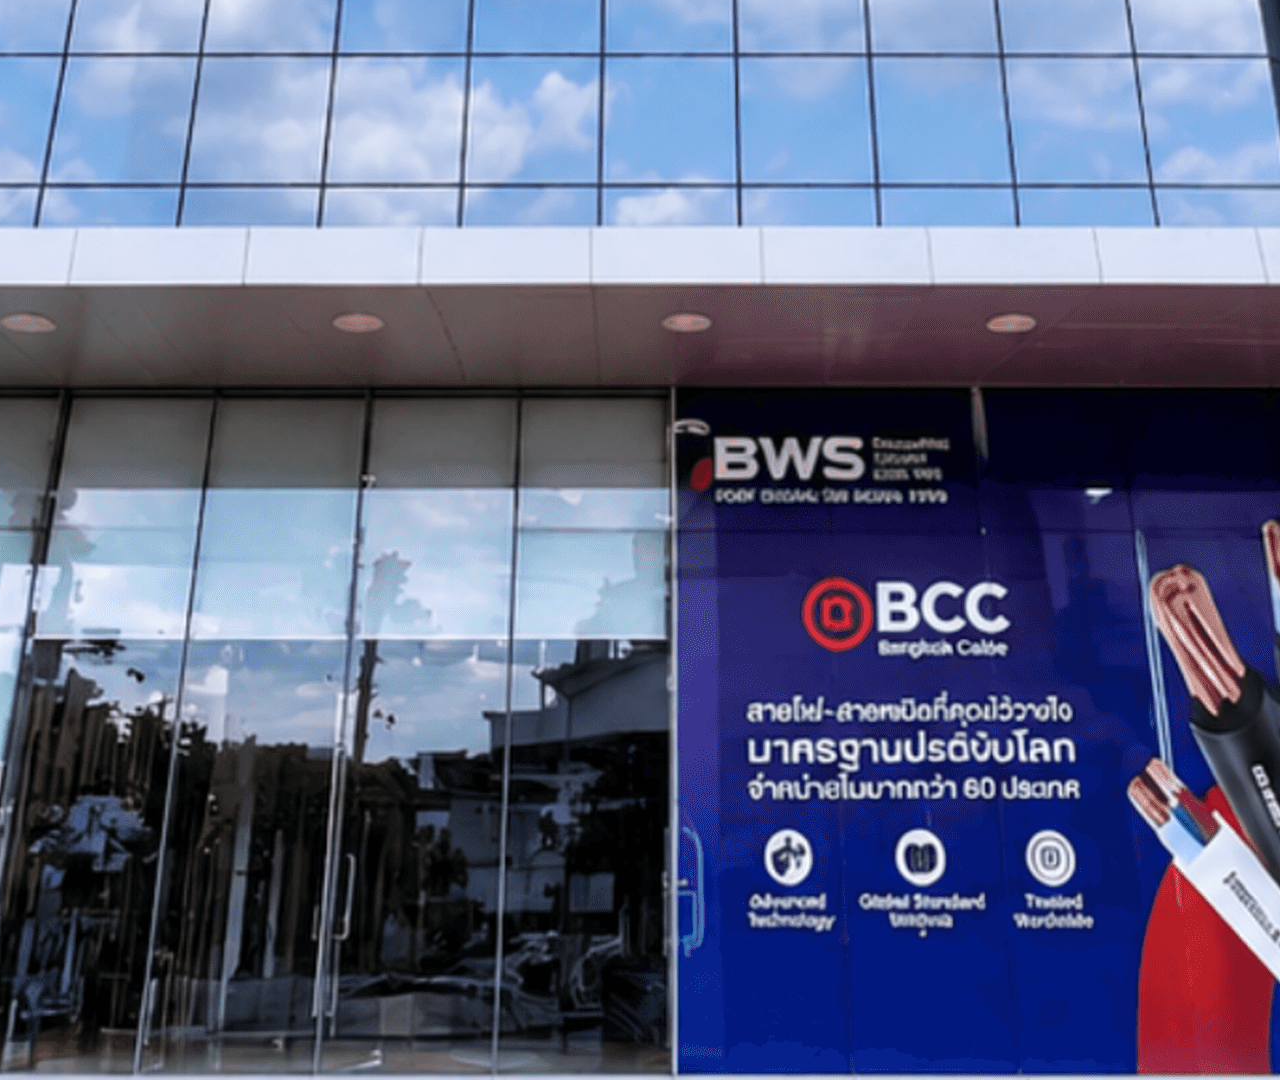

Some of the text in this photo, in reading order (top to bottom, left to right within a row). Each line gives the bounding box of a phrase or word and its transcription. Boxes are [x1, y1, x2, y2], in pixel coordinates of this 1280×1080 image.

[714, 436, 865, 480] BWS
[876, 581, 1011, 634] BCC
[963, 777, 996, 800] 60
